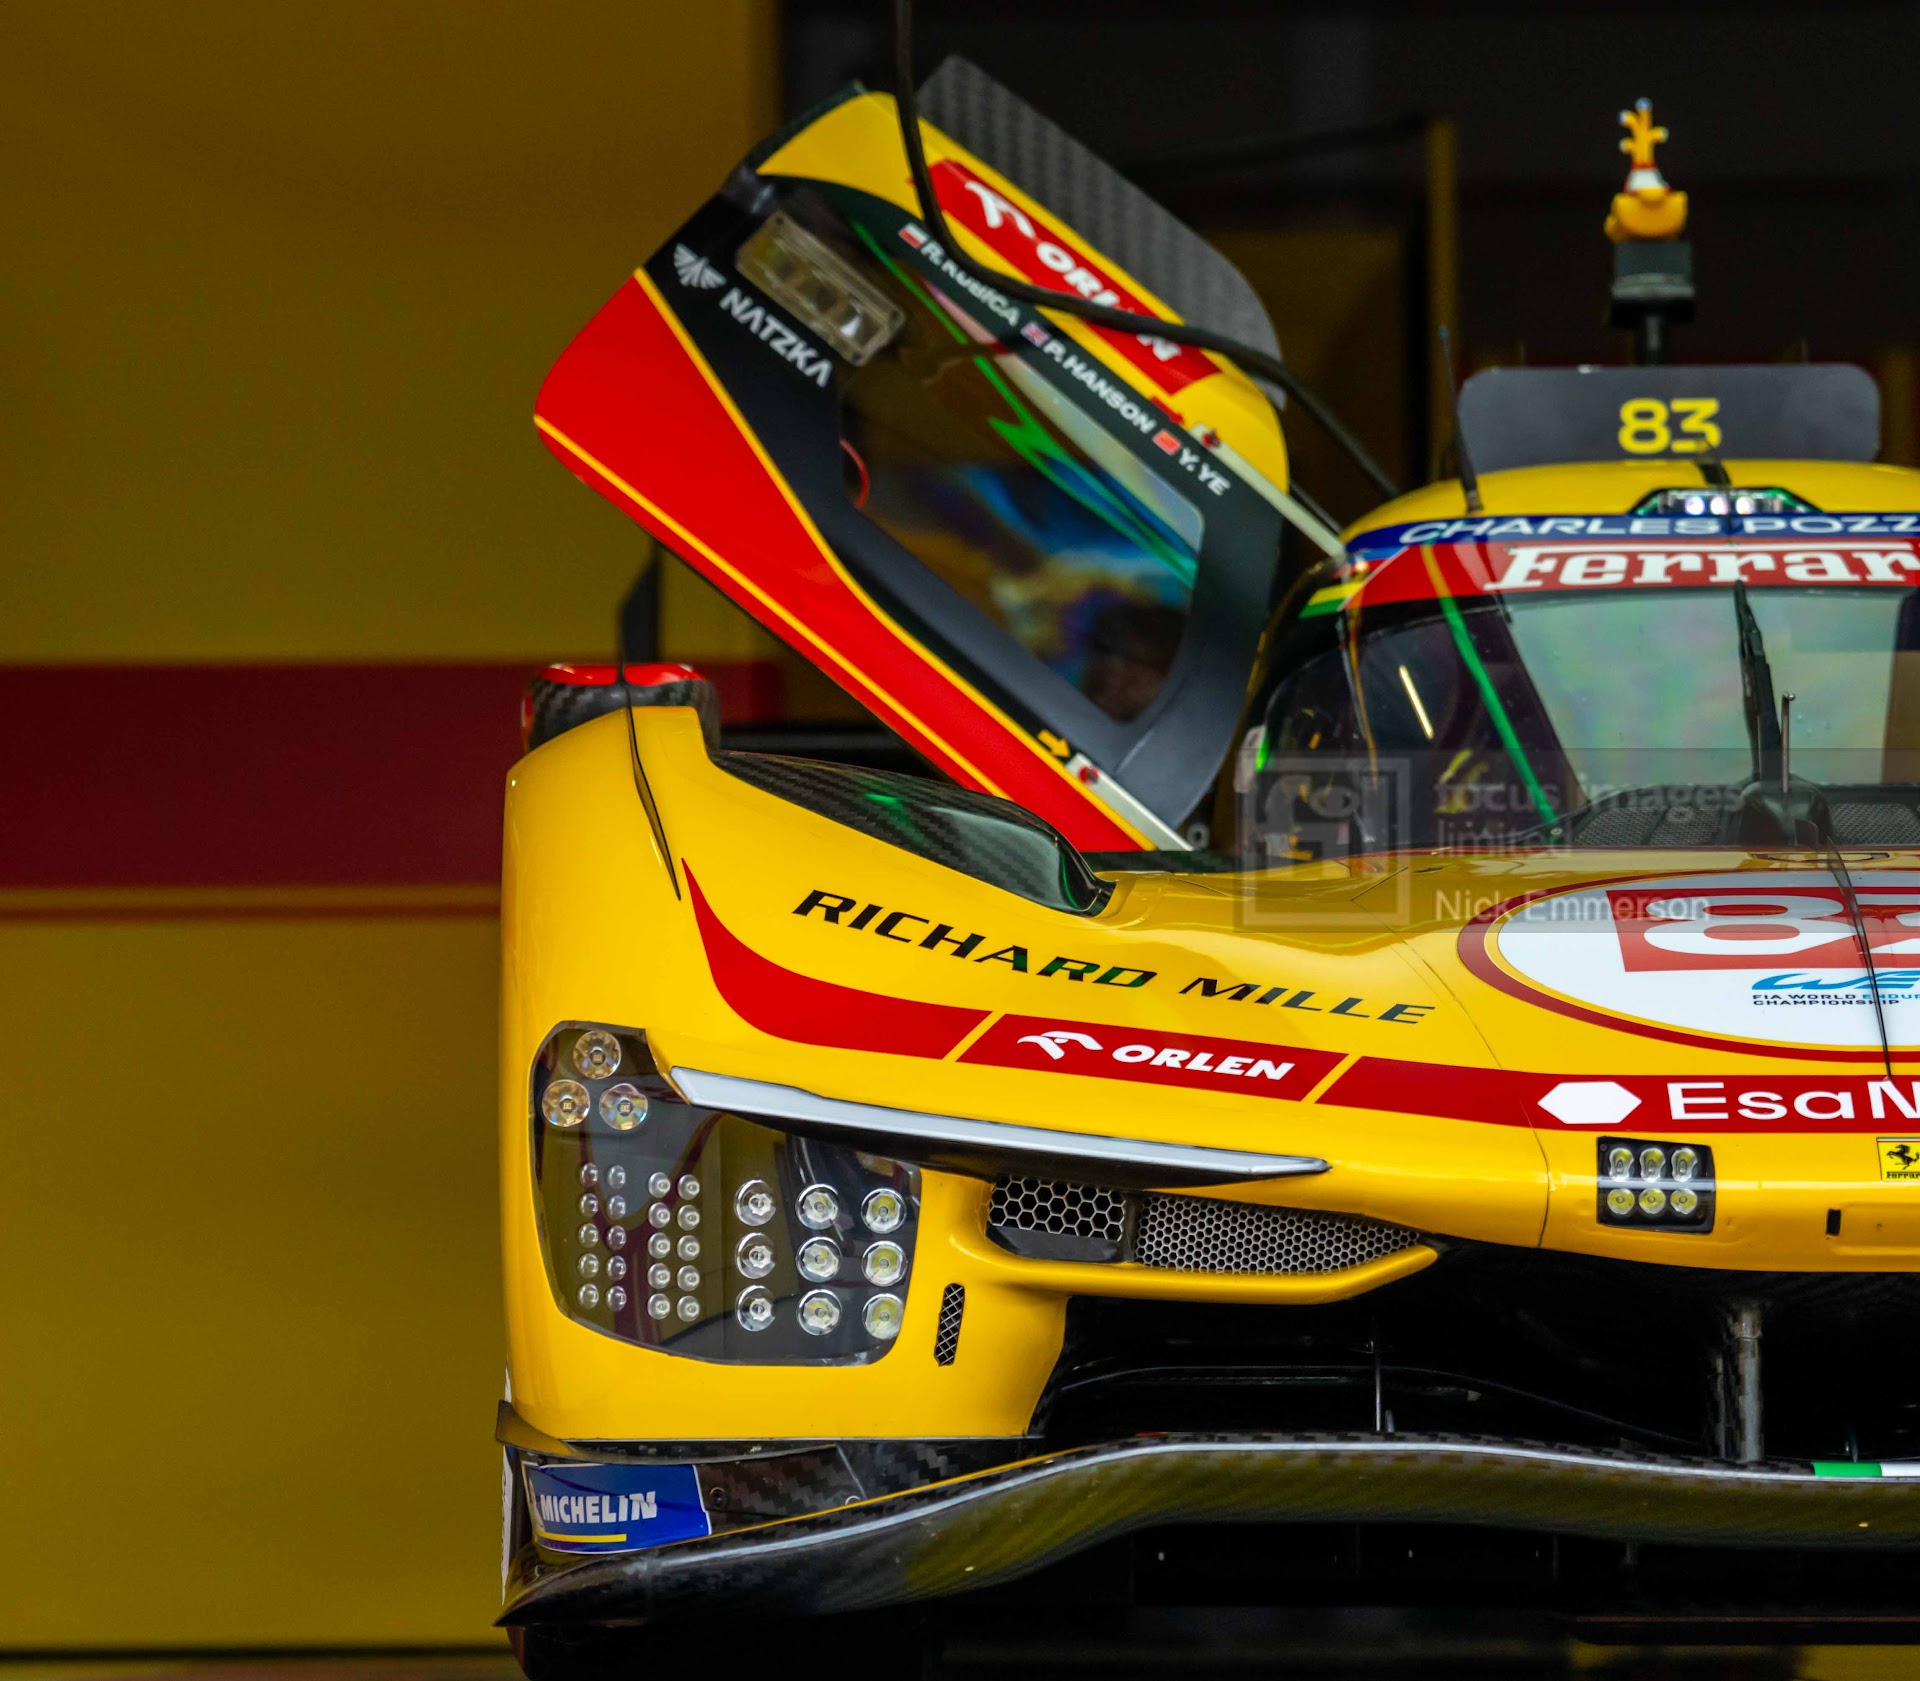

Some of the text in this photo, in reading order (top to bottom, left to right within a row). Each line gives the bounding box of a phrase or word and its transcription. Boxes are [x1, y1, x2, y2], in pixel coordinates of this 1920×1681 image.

[719, 286, 833, 388] NATZKA
[1618, 398, 1721, 454] 83
[1399, 515, 1721, 544] CHARLES
[791, 889, 1436, 1024] RICHARD MILLE
[1112, 1044, 1295, 1081] ORLEN
[1667, 1081, 1920, 1120] EsaN
[540, 1491, 658, 1524] MICHELIN
